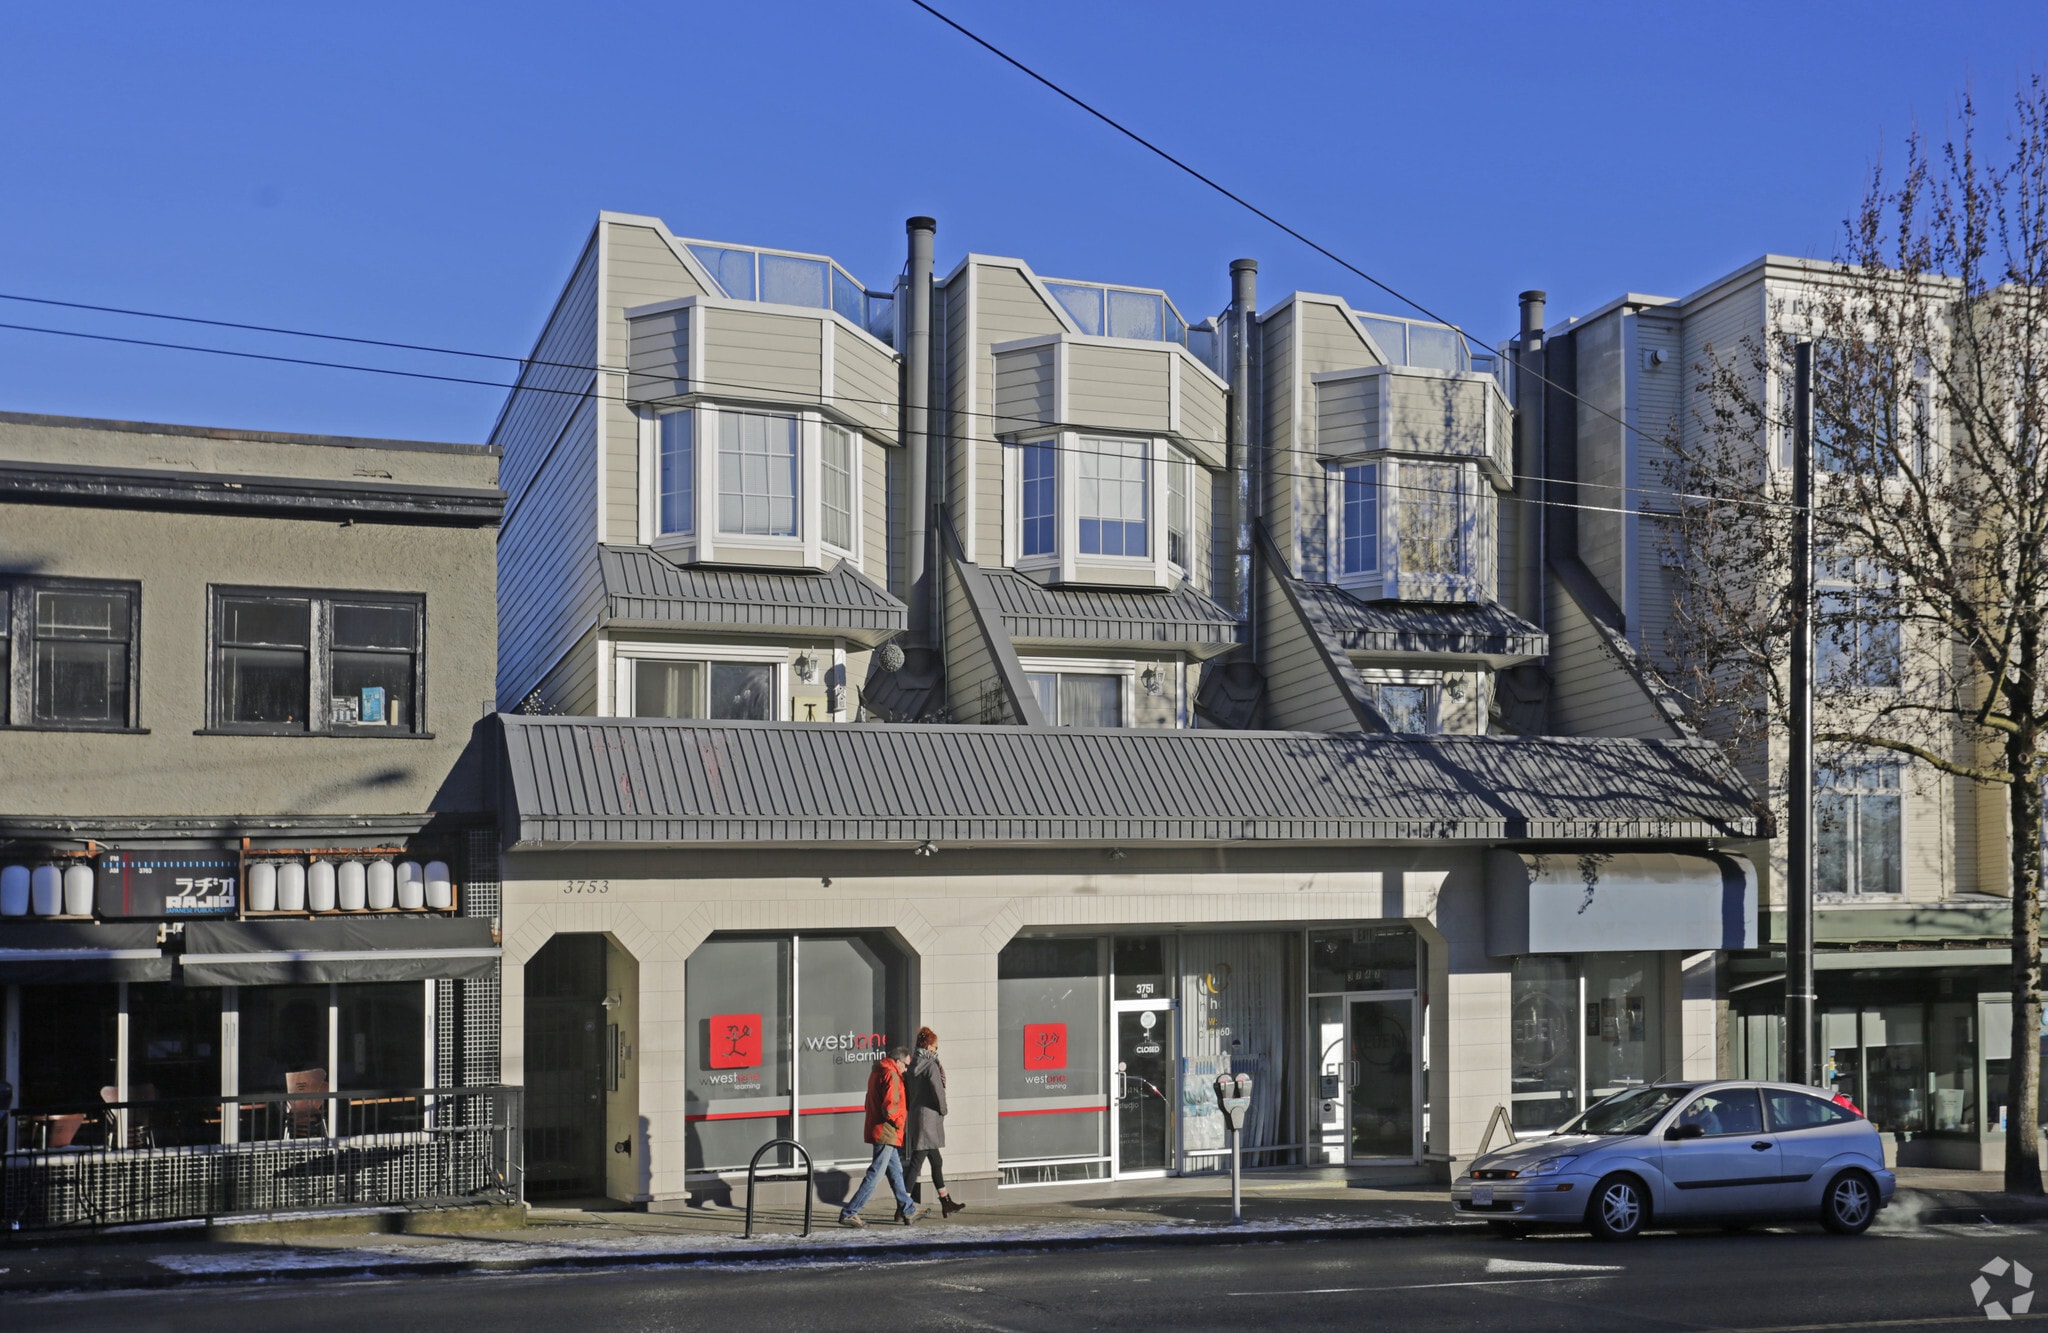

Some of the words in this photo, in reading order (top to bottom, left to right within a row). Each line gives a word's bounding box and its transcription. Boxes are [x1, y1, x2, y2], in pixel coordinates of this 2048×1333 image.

[563, 880, 609, 894] 3753
[166, 896, 235, 908] RAJIO
[1136, 983, 1154, 994] 3751
[845, 1049, 887, 1062] learnin
[1136, 1046, 1160, 1054] CLOSED
